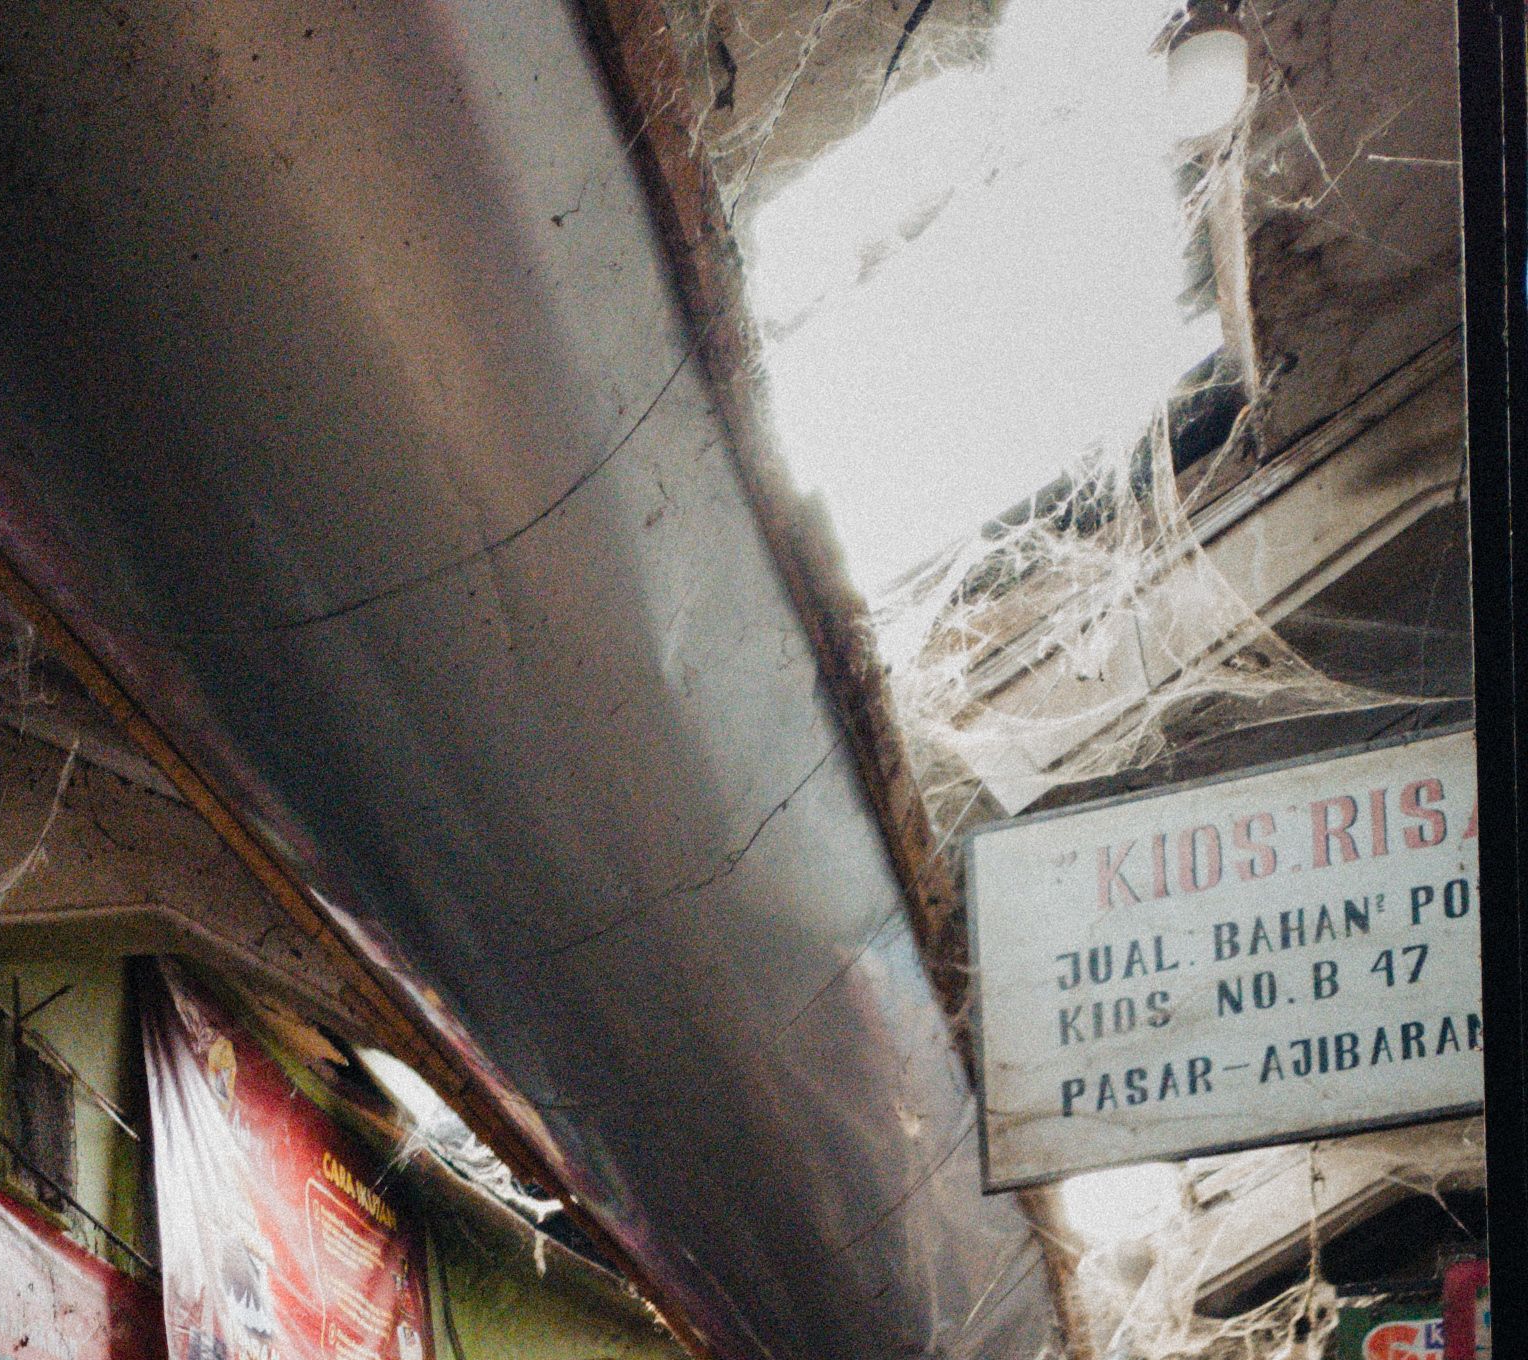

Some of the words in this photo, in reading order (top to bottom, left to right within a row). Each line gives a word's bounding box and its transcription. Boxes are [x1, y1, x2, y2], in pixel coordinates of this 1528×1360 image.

[1310, 777, 1478, 871] RIS
[1409, 877, 1471, 926] PO
[1058, 989, 1172, 1046] KIOS
[1216, 970, 1297, 1018] NO.
[1312, 959, 1342, 1001] B
[1370, 943, 1432, 988] 47
[1060, 1012, 1482, 1119] PASAR-AJIBARAN
